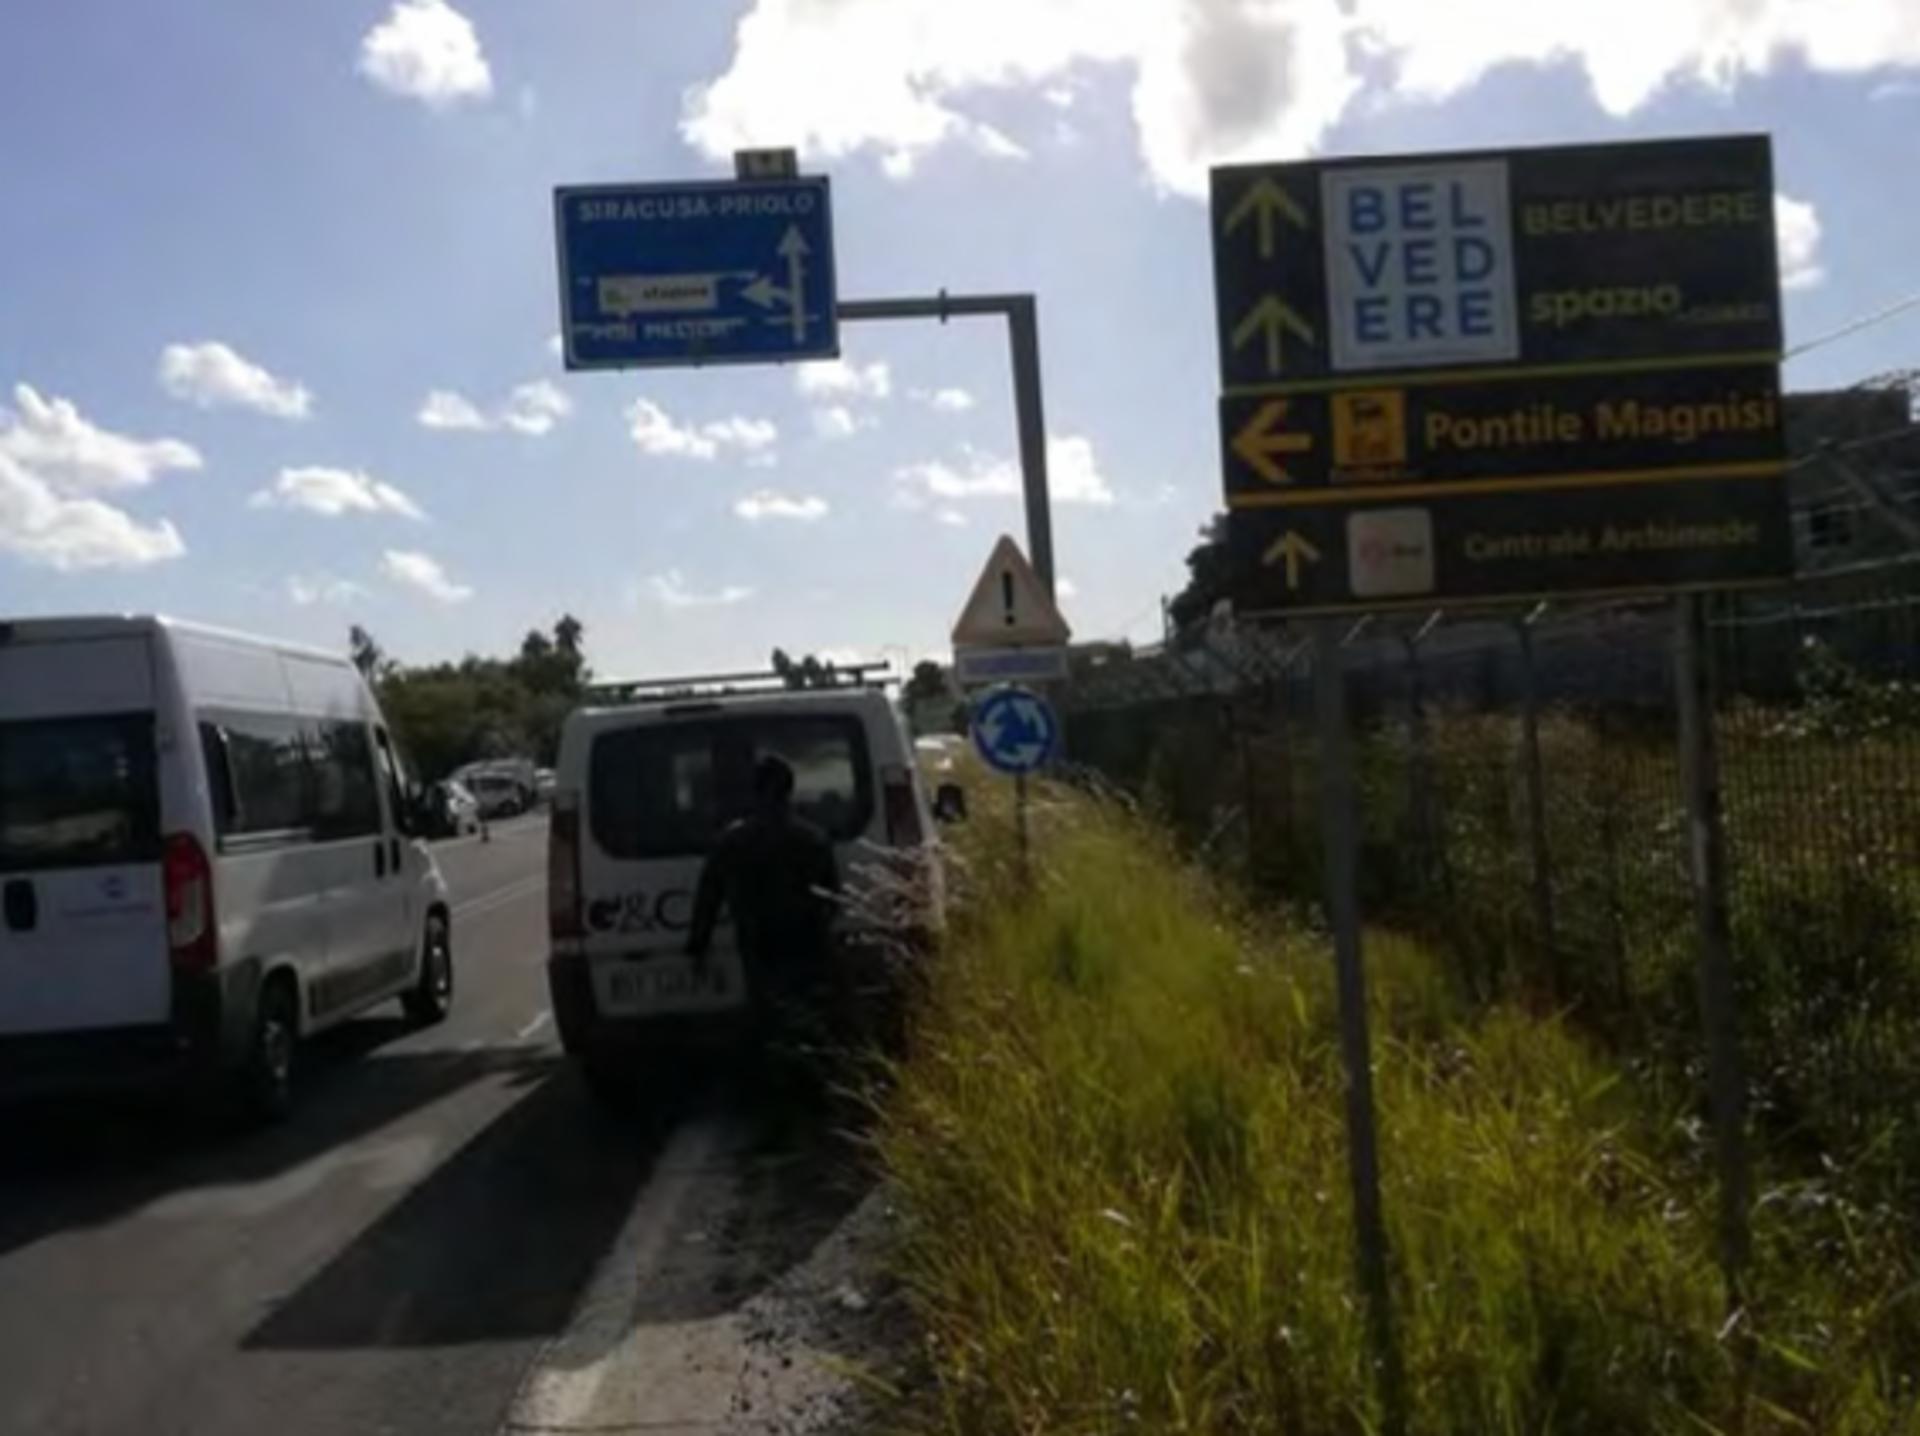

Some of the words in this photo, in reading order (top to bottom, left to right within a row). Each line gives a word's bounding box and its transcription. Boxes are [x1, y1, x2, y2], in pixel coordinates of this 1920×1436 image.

[1348, 184, 1484, 234] BEL
[1523, 192, 1758, 235] BELVEDERE
[1348, 237, 1494, 286] VED
[1355, 292, 1493, 343] ERE
[1531, 284, 1682, 327] spazio
[1424, 405, 1581, 449] Pontile
[1595, 391, 1776, 442] Magnisi
[1464, 528, 1588, 560] Centrale
[1601, 520, 1758, 550] Archimede
